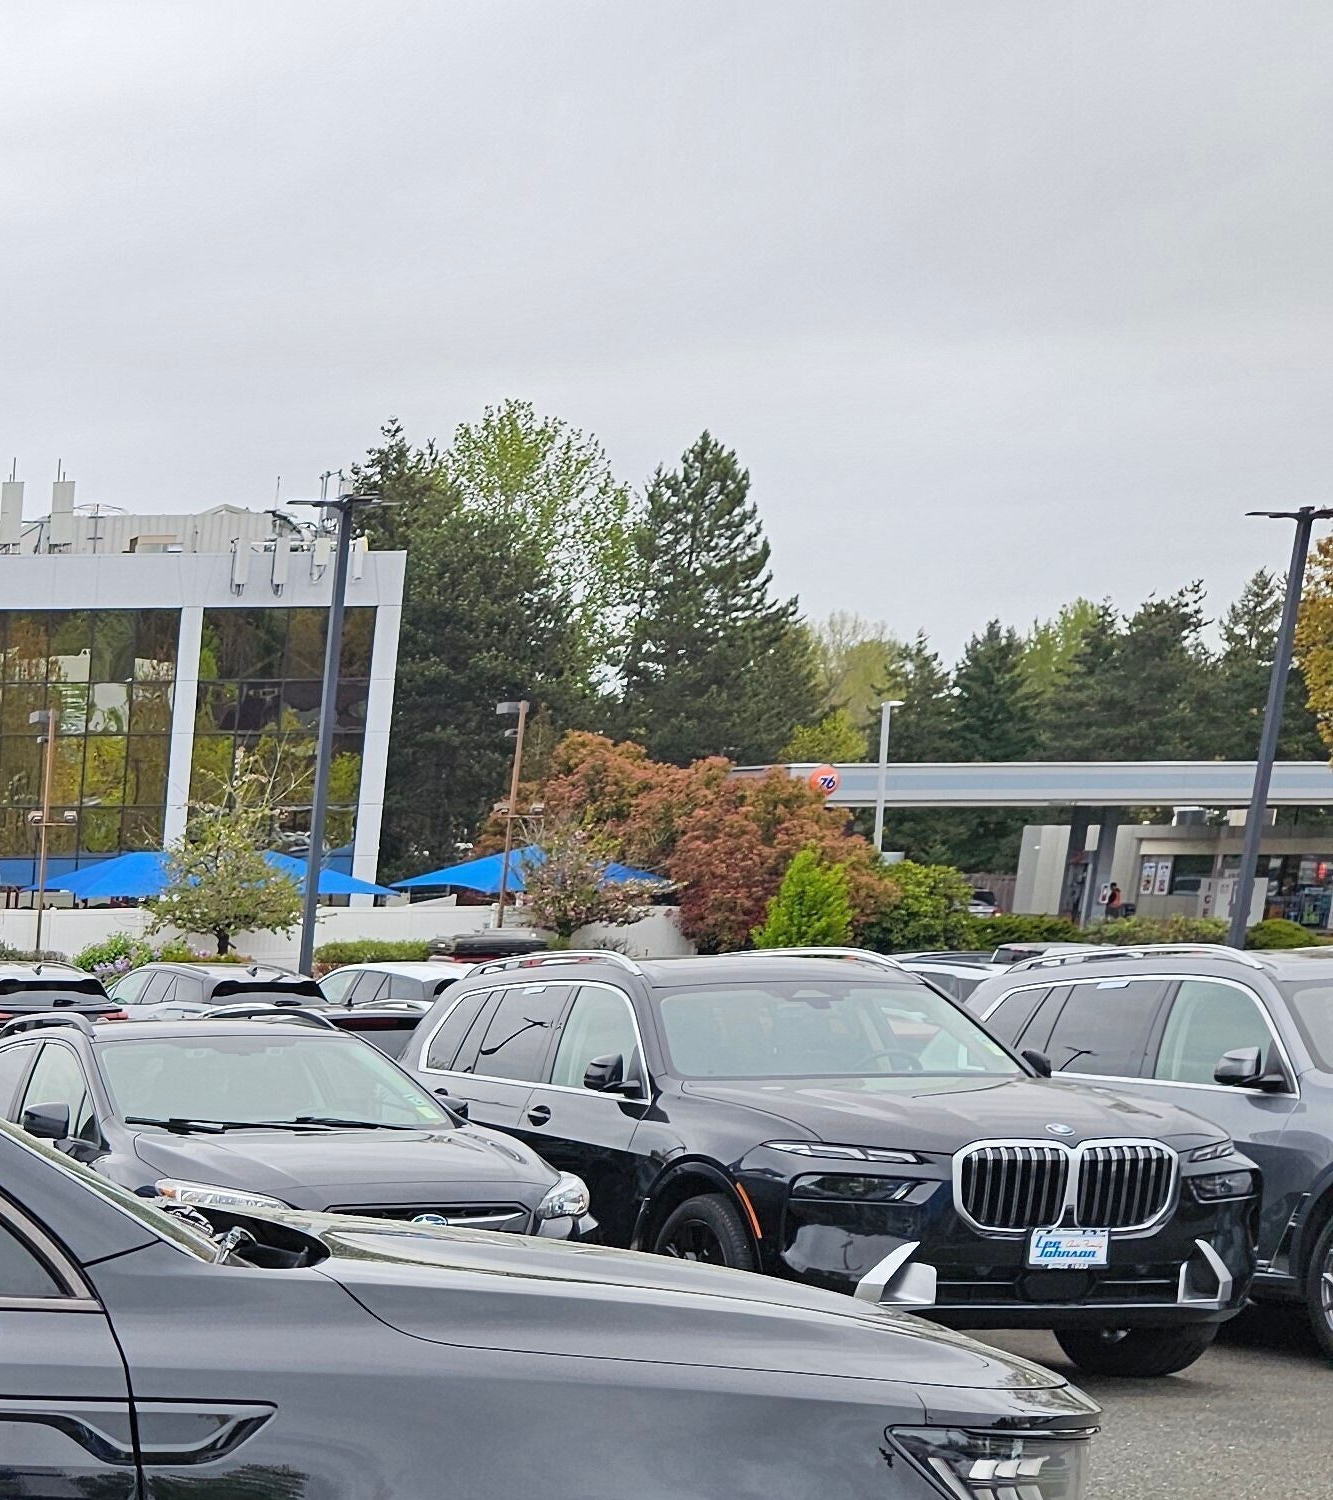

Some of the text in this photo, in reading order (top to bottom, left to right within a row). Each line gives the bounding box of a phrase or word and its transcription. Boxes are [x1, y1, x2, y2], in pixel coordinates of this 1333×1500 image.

[820, 775, 836, 790] 76
[1202, 881, 1212, 918] ICE
[1035, 1235, 1061, 1248] Lee
[1036, 1246, 1097, 1258] Johnson
